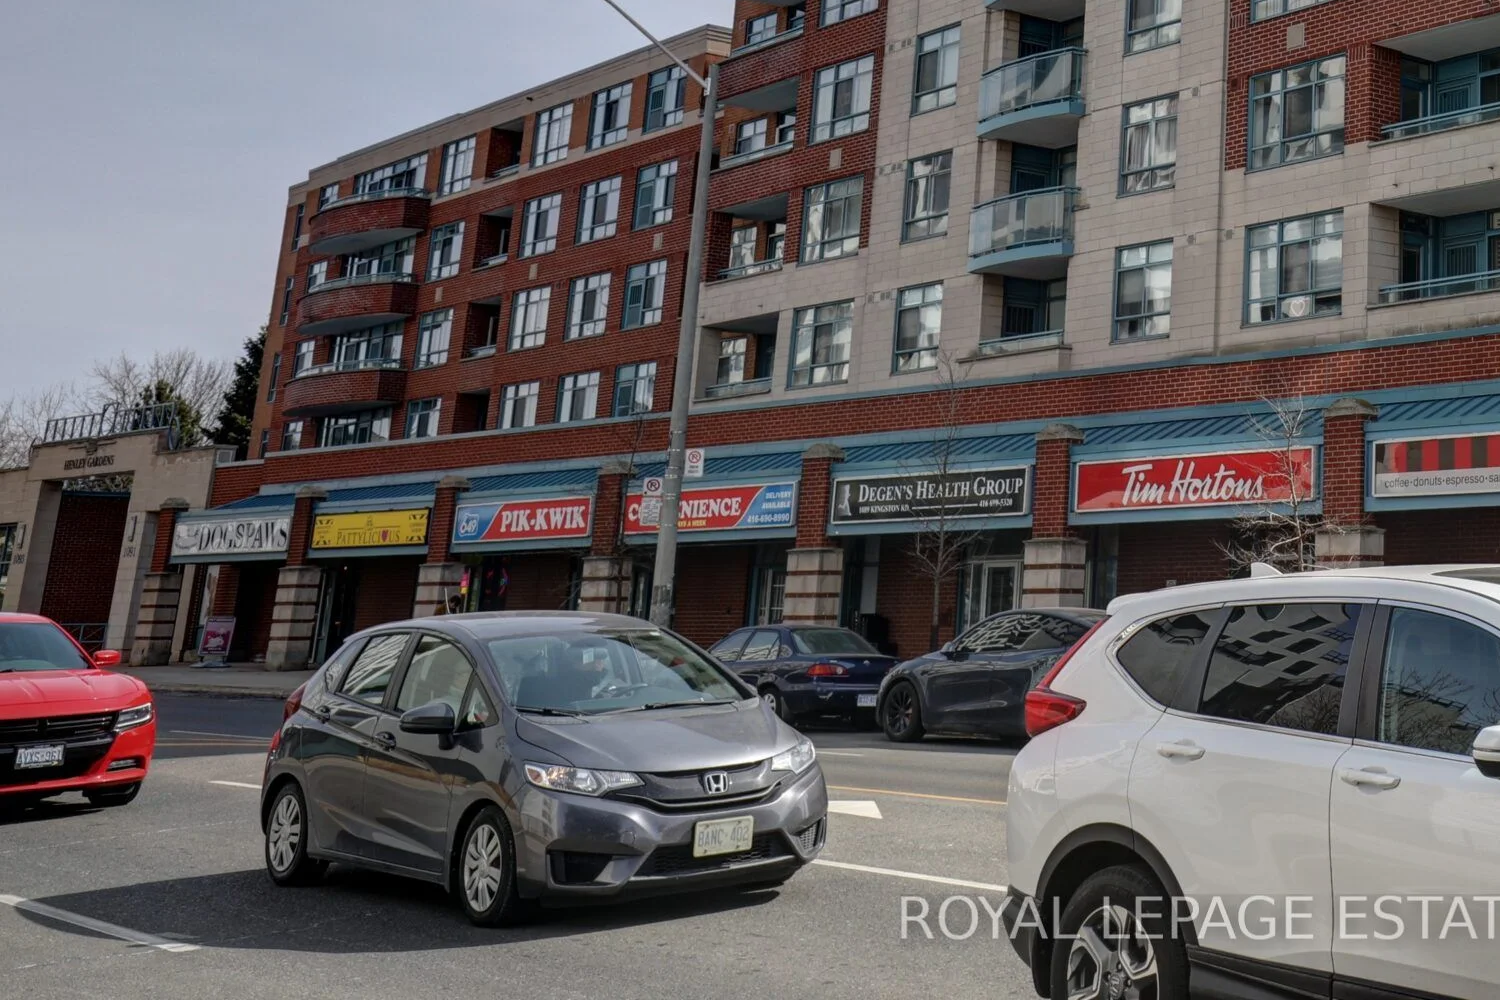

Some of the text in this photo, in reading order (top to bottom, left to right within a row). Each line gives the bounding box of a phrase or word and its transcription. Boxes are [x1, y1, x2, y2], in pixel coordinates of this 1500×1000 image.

[63, 454, 115, 471] HENLEY GARDENS
[858, 475, 1024, 503] DEGEN'S HEALTH GROUP
[1121, 460, 1263, 506] Tim Hortons
[1384, 478, 1410, 489] coffee
[1413, 476, 1442, 487] donuts
[1445, 474, 1485, 486] espresso
[627, 496, 742, 521] CNIENCE
[870, 504, 899, 514] KINGSTON
[199, 521, 288, 551] DOGSPAWS
[698, 825, 750, 848] BANC 402
